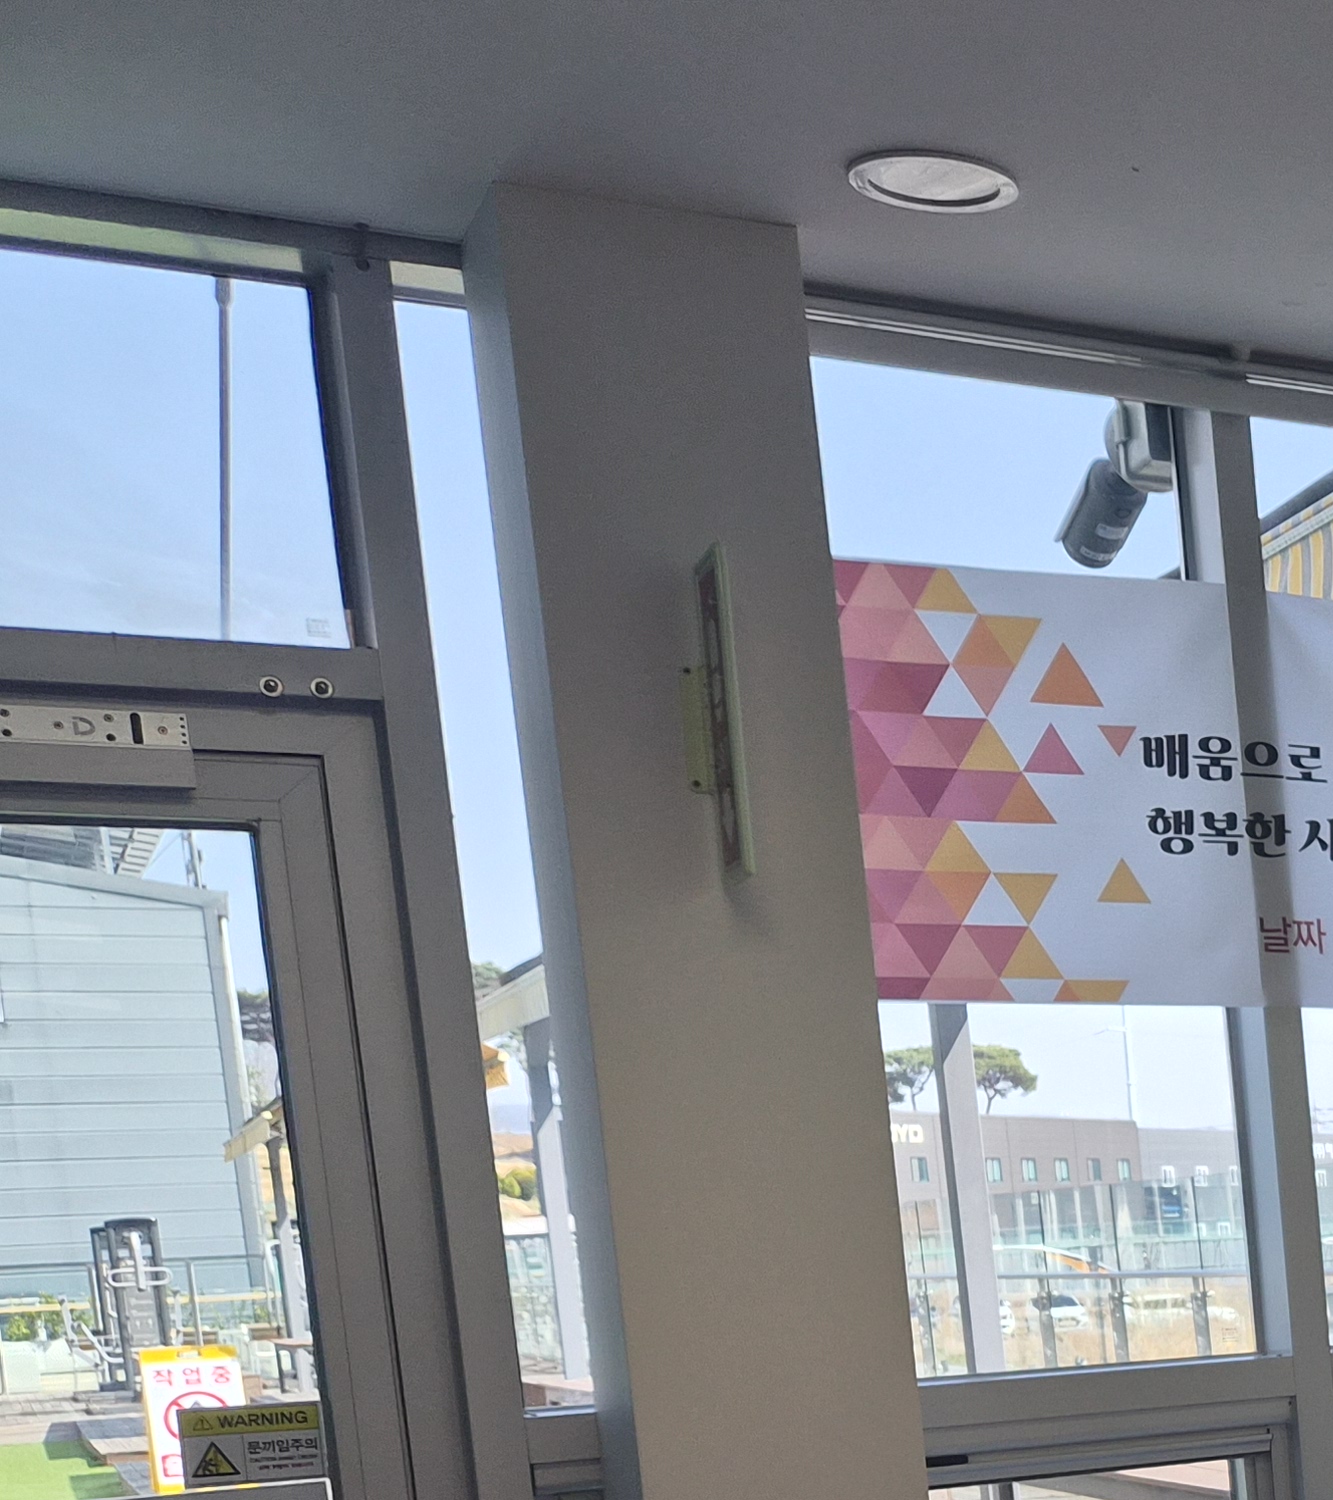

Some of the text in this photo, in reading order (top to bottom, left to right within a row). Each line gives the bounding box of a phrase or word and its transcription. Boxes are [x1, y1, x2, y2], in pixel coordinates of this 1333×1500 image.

[1139, 733, 1328, 784] 배움으로
[1146, 807, 1291, 858] 행복한
[1258, 916, 1327, 955] 날짜
[217, 1410, 308, 1429] WARNING
[248, 1437, 318, 1455] 문끼임주의
